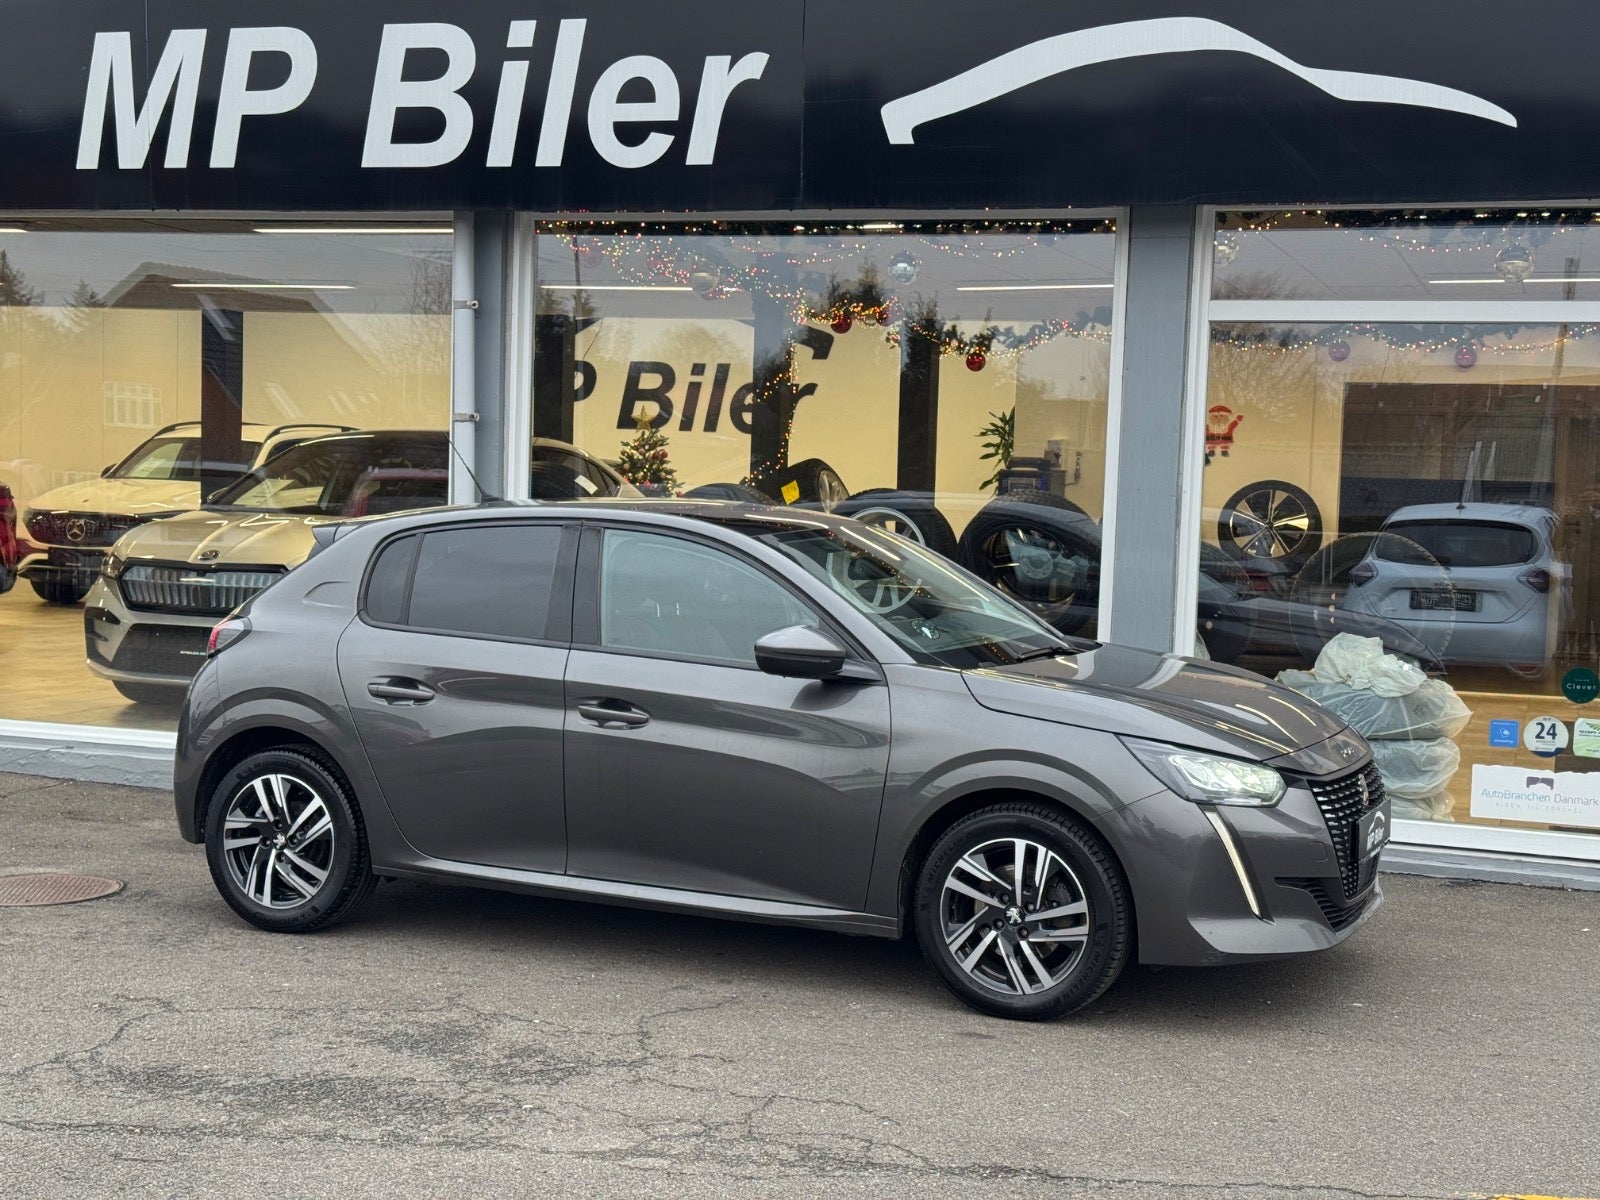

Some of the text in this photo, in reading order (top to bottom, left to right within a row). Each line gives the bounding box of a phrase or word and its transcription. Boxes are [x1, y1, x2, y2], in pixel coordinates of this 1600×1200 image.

[76, 19, 769, 169] MP Biler
[1566, 682, 1597, 691] Clever
[1535, 722, 1557, 740] 24
[1481, 788, 1599, 806] AutoBranchen Danmark
[1062, 950, 1101, 1000] MICHELIN
